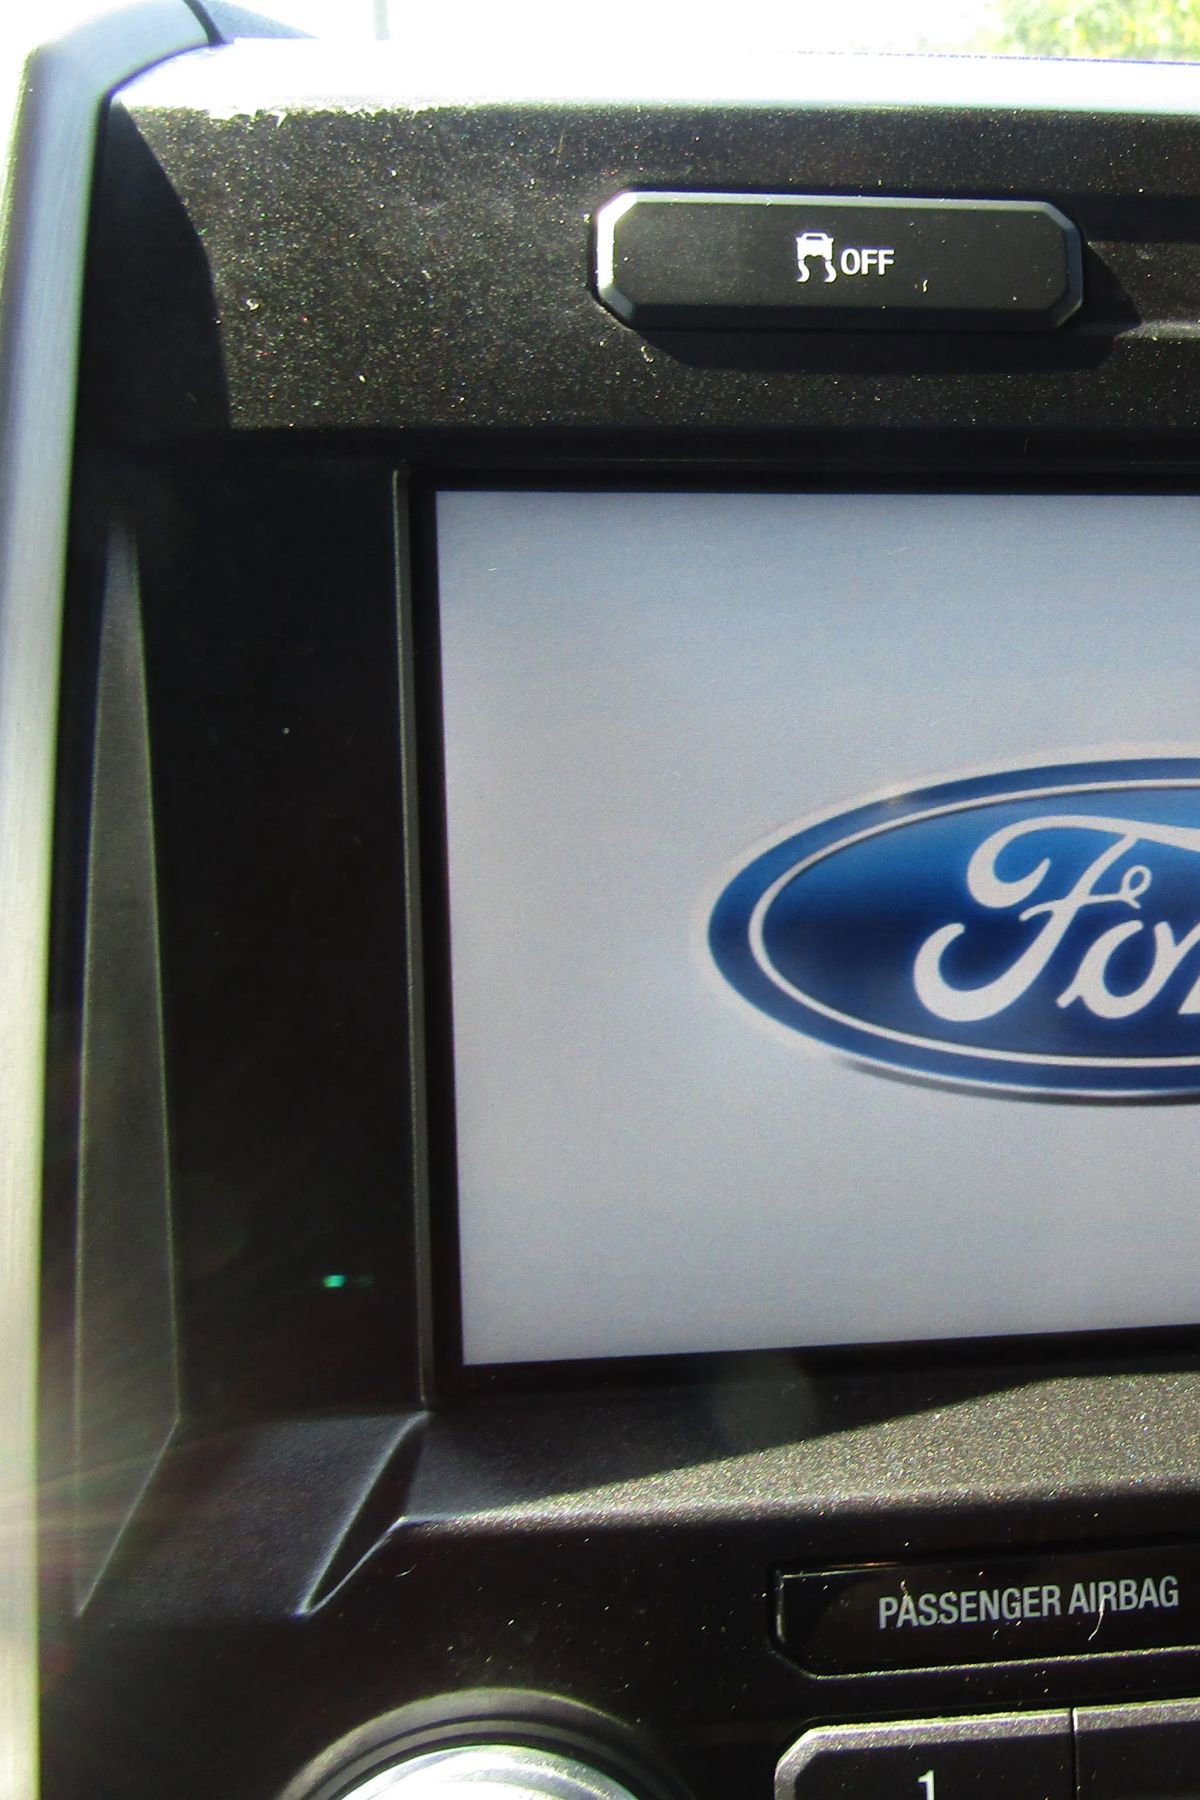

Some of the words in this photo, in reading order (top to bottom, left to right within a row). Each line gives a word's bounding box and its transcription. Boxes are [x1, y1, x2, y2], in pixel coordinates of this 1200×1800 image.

[840, 248, 895, 277] OFF
[878, 1584, 1062, 1630] PASSENGER
[1067, 1575, 1180, 1616] AIRBAG
[917, 1769, 935, 1800] 1
